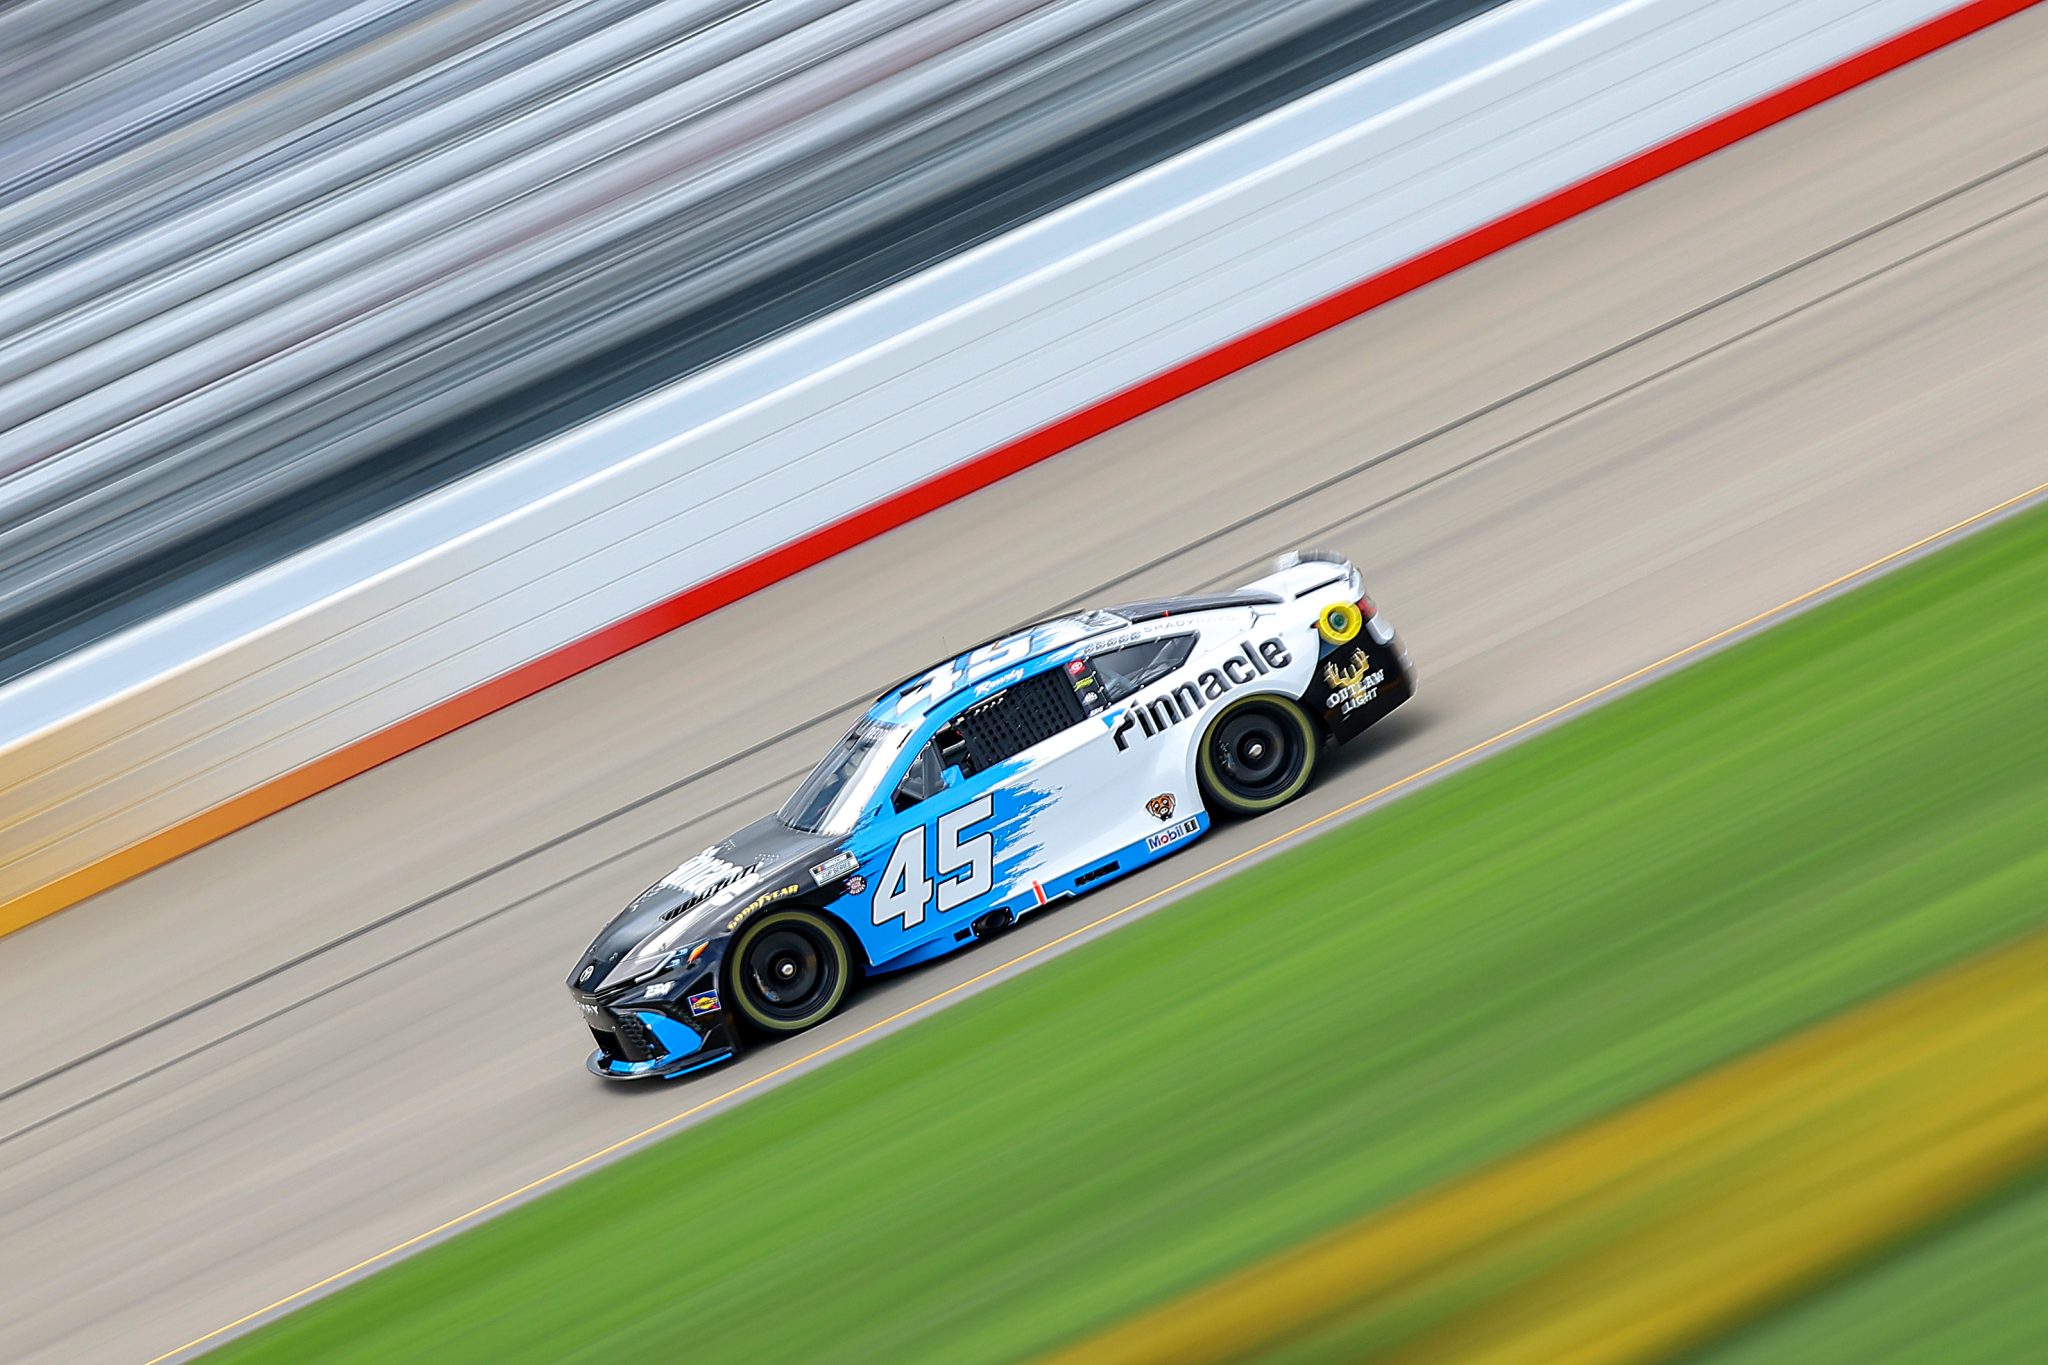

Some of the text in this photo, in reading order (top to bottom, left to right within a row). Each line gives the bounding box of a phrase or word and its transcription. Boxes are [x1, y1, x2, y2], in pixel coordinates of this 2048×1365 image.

[974, 667, 1025, 698] Rowdy
[1103, 634, 1293, 753] Pinnacle
[1326, 668, 1385, 709] OUTLAW
[1341, 687, 1378, 715] LIGHT
[1148, 820, 1197, 850] Mobil 1
[872, 793, 995, 931] 45
[726, 884, 799, 932] GOODYEAR
